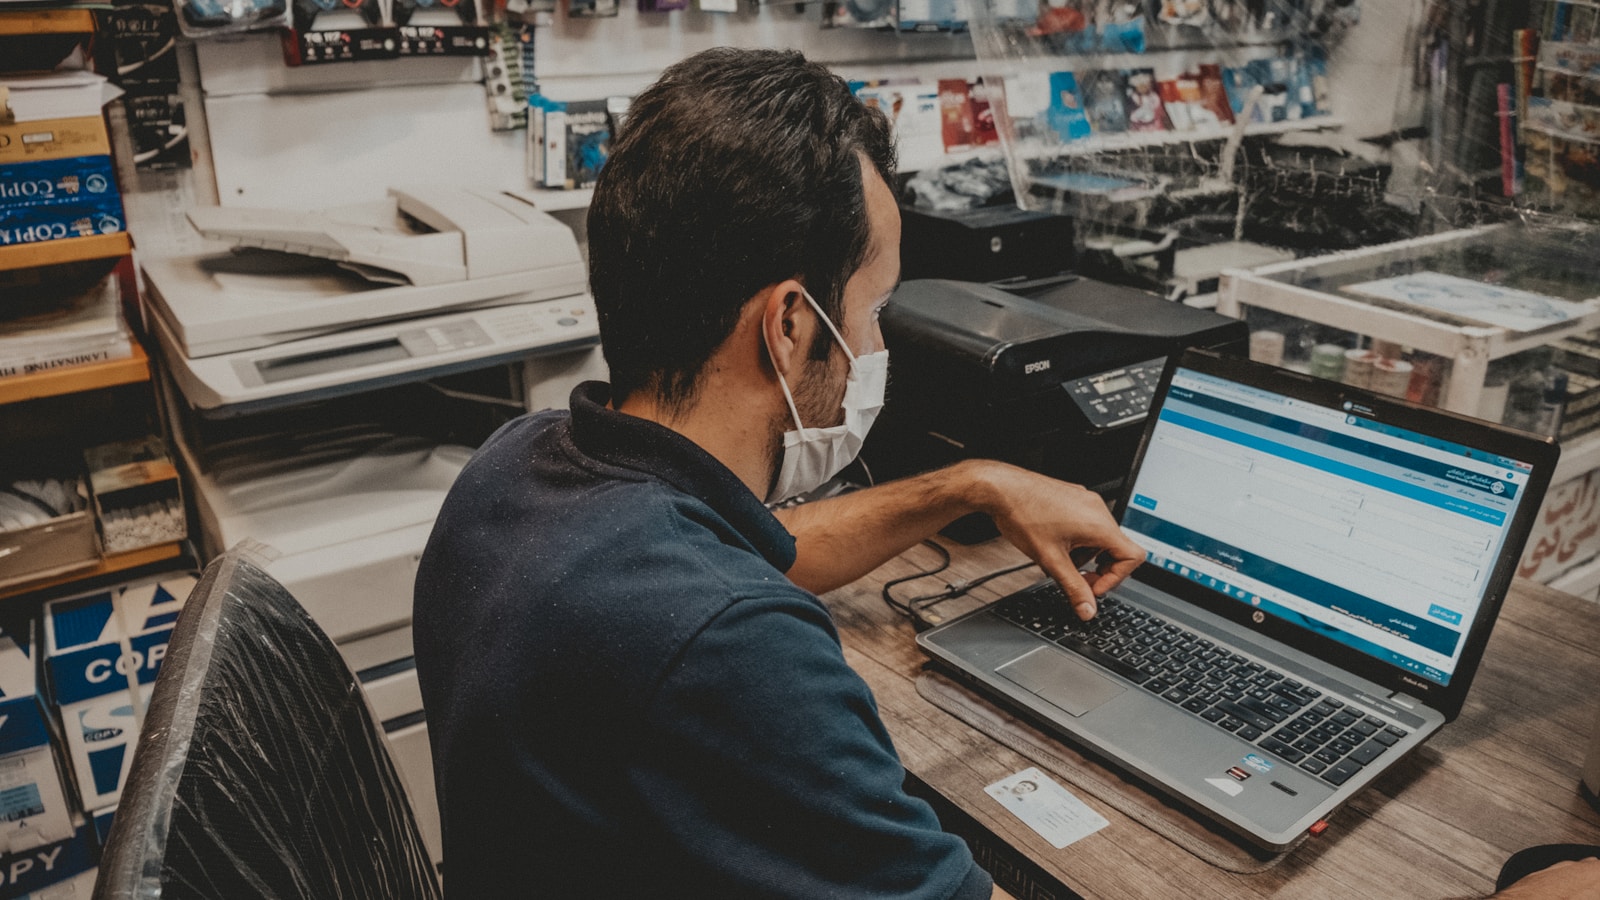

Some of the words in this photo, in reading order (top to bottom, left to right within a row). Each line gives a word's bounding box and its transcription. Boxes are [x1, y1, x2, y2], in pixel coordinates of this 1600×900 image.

[1024, 360, 1051, 374] EPSON
[84, 643, 169, 684] COP
[0, 846, 63, 888] PY
